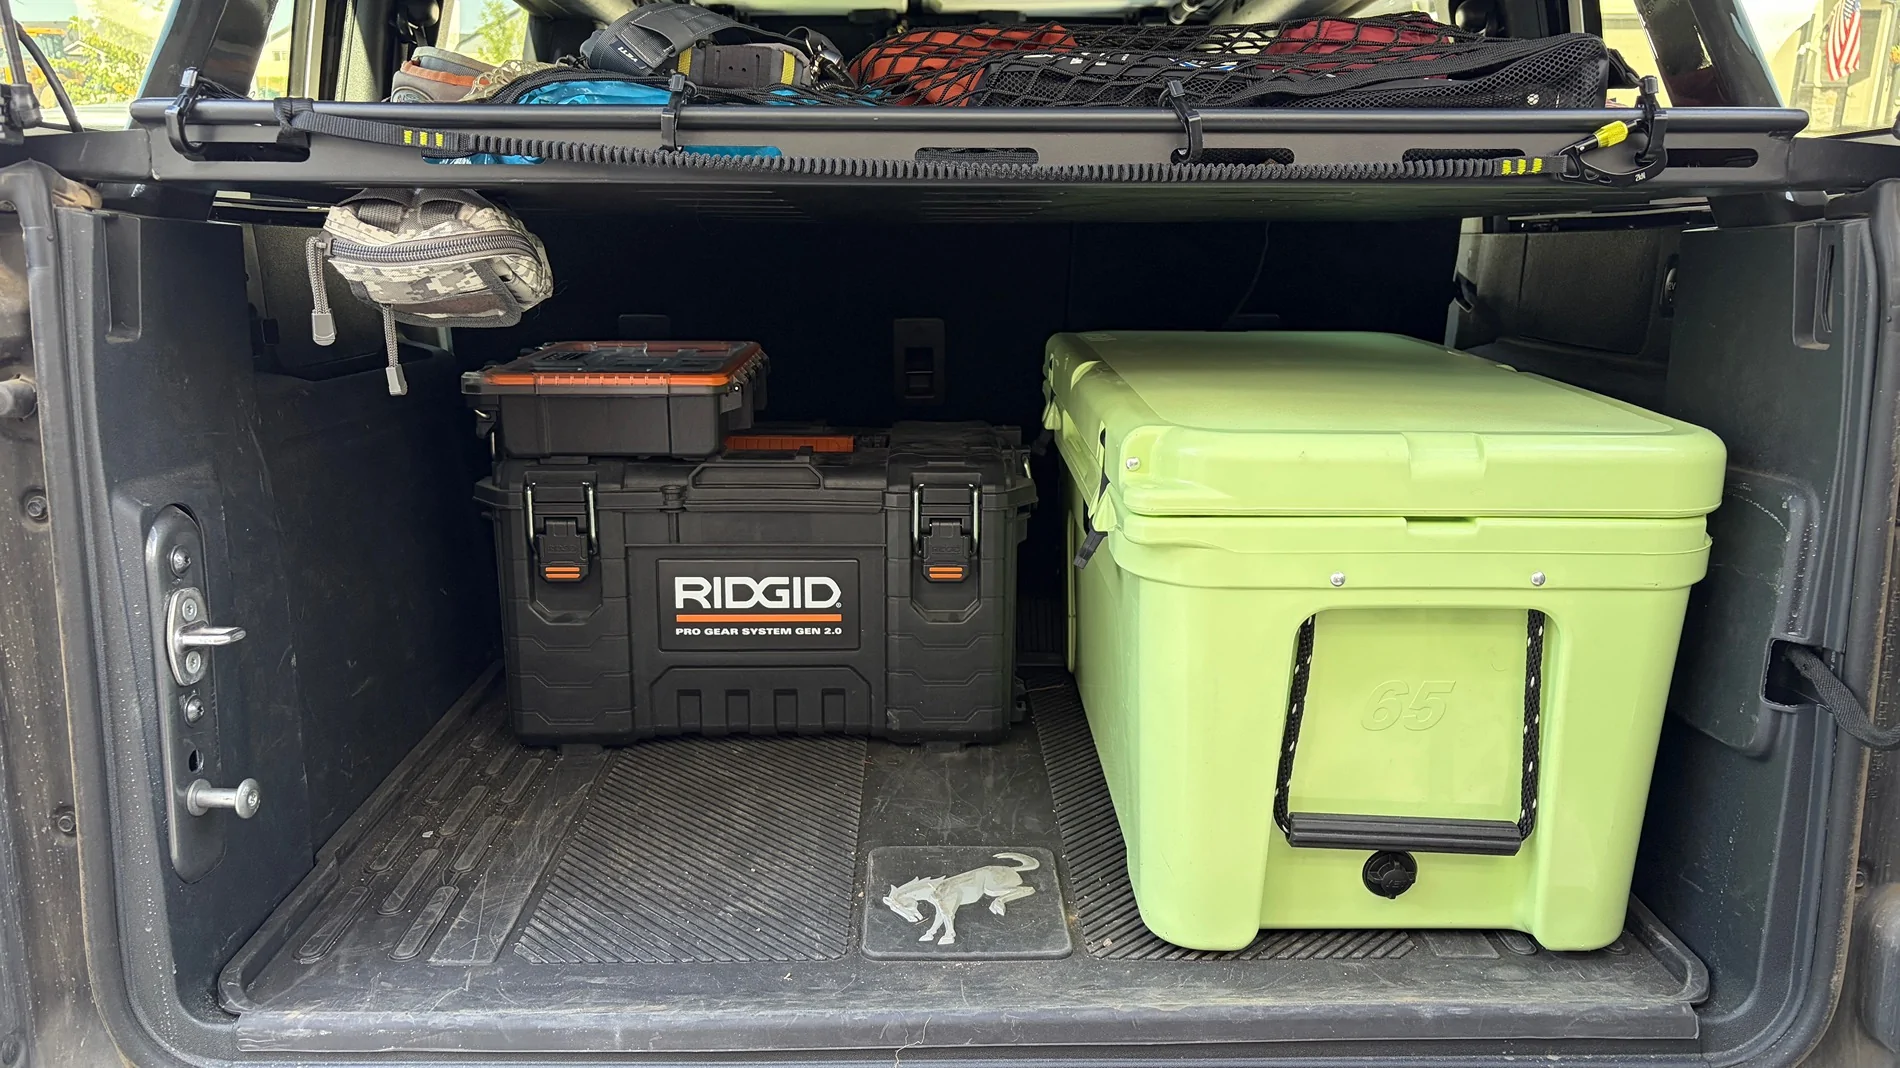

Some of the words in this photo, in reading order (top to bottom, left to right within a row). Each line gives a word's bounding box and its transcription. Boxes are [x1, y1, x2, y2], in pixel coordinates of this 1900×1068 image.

[618, 46, 638, 63] YETI
[675, 627, 701, 636] PRO
[704, 627, 739, 636] GEAR
[741, 627, 792, 636] SYSTEM
[795, 627, 821, 636] GEN
[824, 627, 842, 635] 2.0
[1361, 680, 1456, 731] 65
